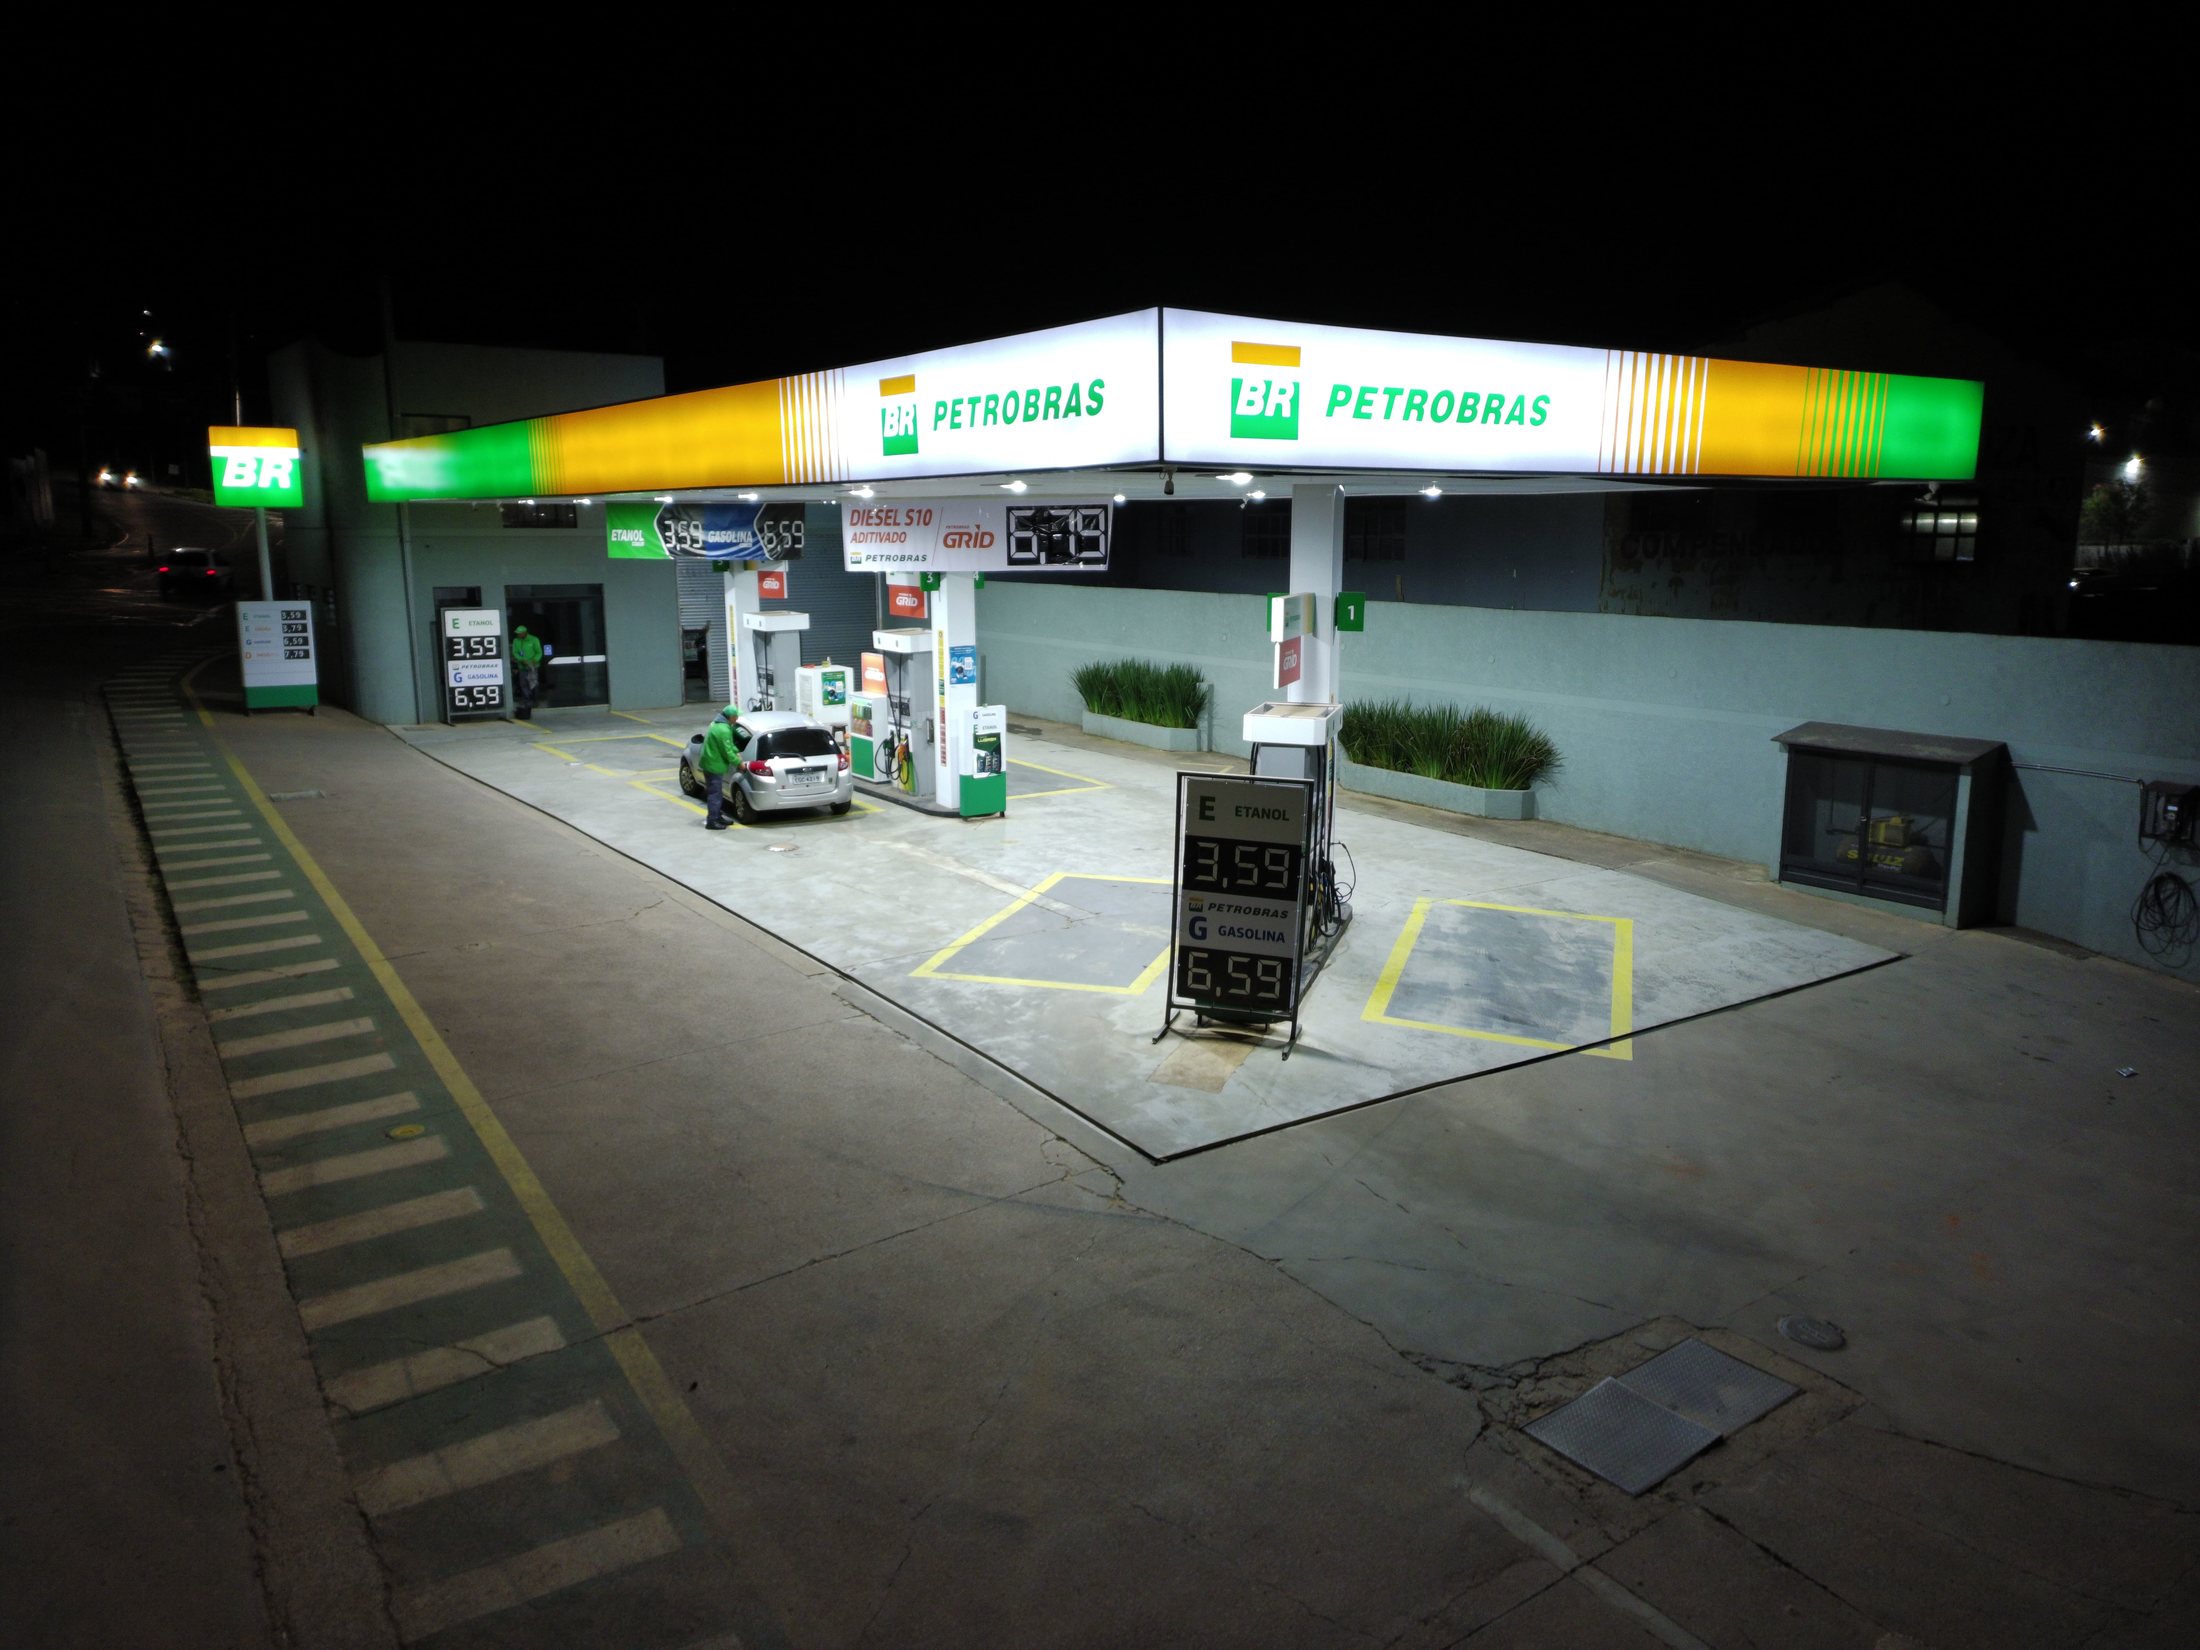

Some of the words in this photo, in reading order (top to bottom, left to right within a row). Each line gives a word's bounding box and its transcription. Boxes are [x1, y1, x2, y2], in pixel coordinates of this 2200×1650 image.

[883, 404, 915, 437] BR
[933, 379, 1105, 431] PETROBRAS
[1235, 379, 1295, 418] BR
[1326, 384, 1551, 426] PETROBRAS
[222, 456, 293, 488] BR
[850, 508, 901, 526] DIESEL
[904, 508, 933, 526] S10
[611, 529, 645, 542] ETANOL
[664, 520, 703, 551] 3,59
[707, 530, 753, 543] GASOLINA
[764, 520, 804, 552] 6,59
[850, 531, 907, 544] ADITIVADO
[942, 525, 995, 549] GRID
[865, 554, 927, 562] PETROBRAS
[895, 594, 918, 607] GRID
[452, 618, 460, 629] E
[1347, 605, 1354, 621] 1
[452, 637, 497, 659] 3,59
[453, 672, 463, 683] G
[454, 686, 500, 708] 6,59
[972, 711, 979, 720] G
[1199, 796, 1216, 821] E
[1234, 805, 1290, 822] ETANOL
[1194, 842, 1290, 889] 3,59
[1208, 902, 1289, 919] PETROBRAS
[1188, 916, 1208, 941] G
[1218, 924, 1286, 944] GASOLINA
[1187, 951, 1282, 999] 6,59
